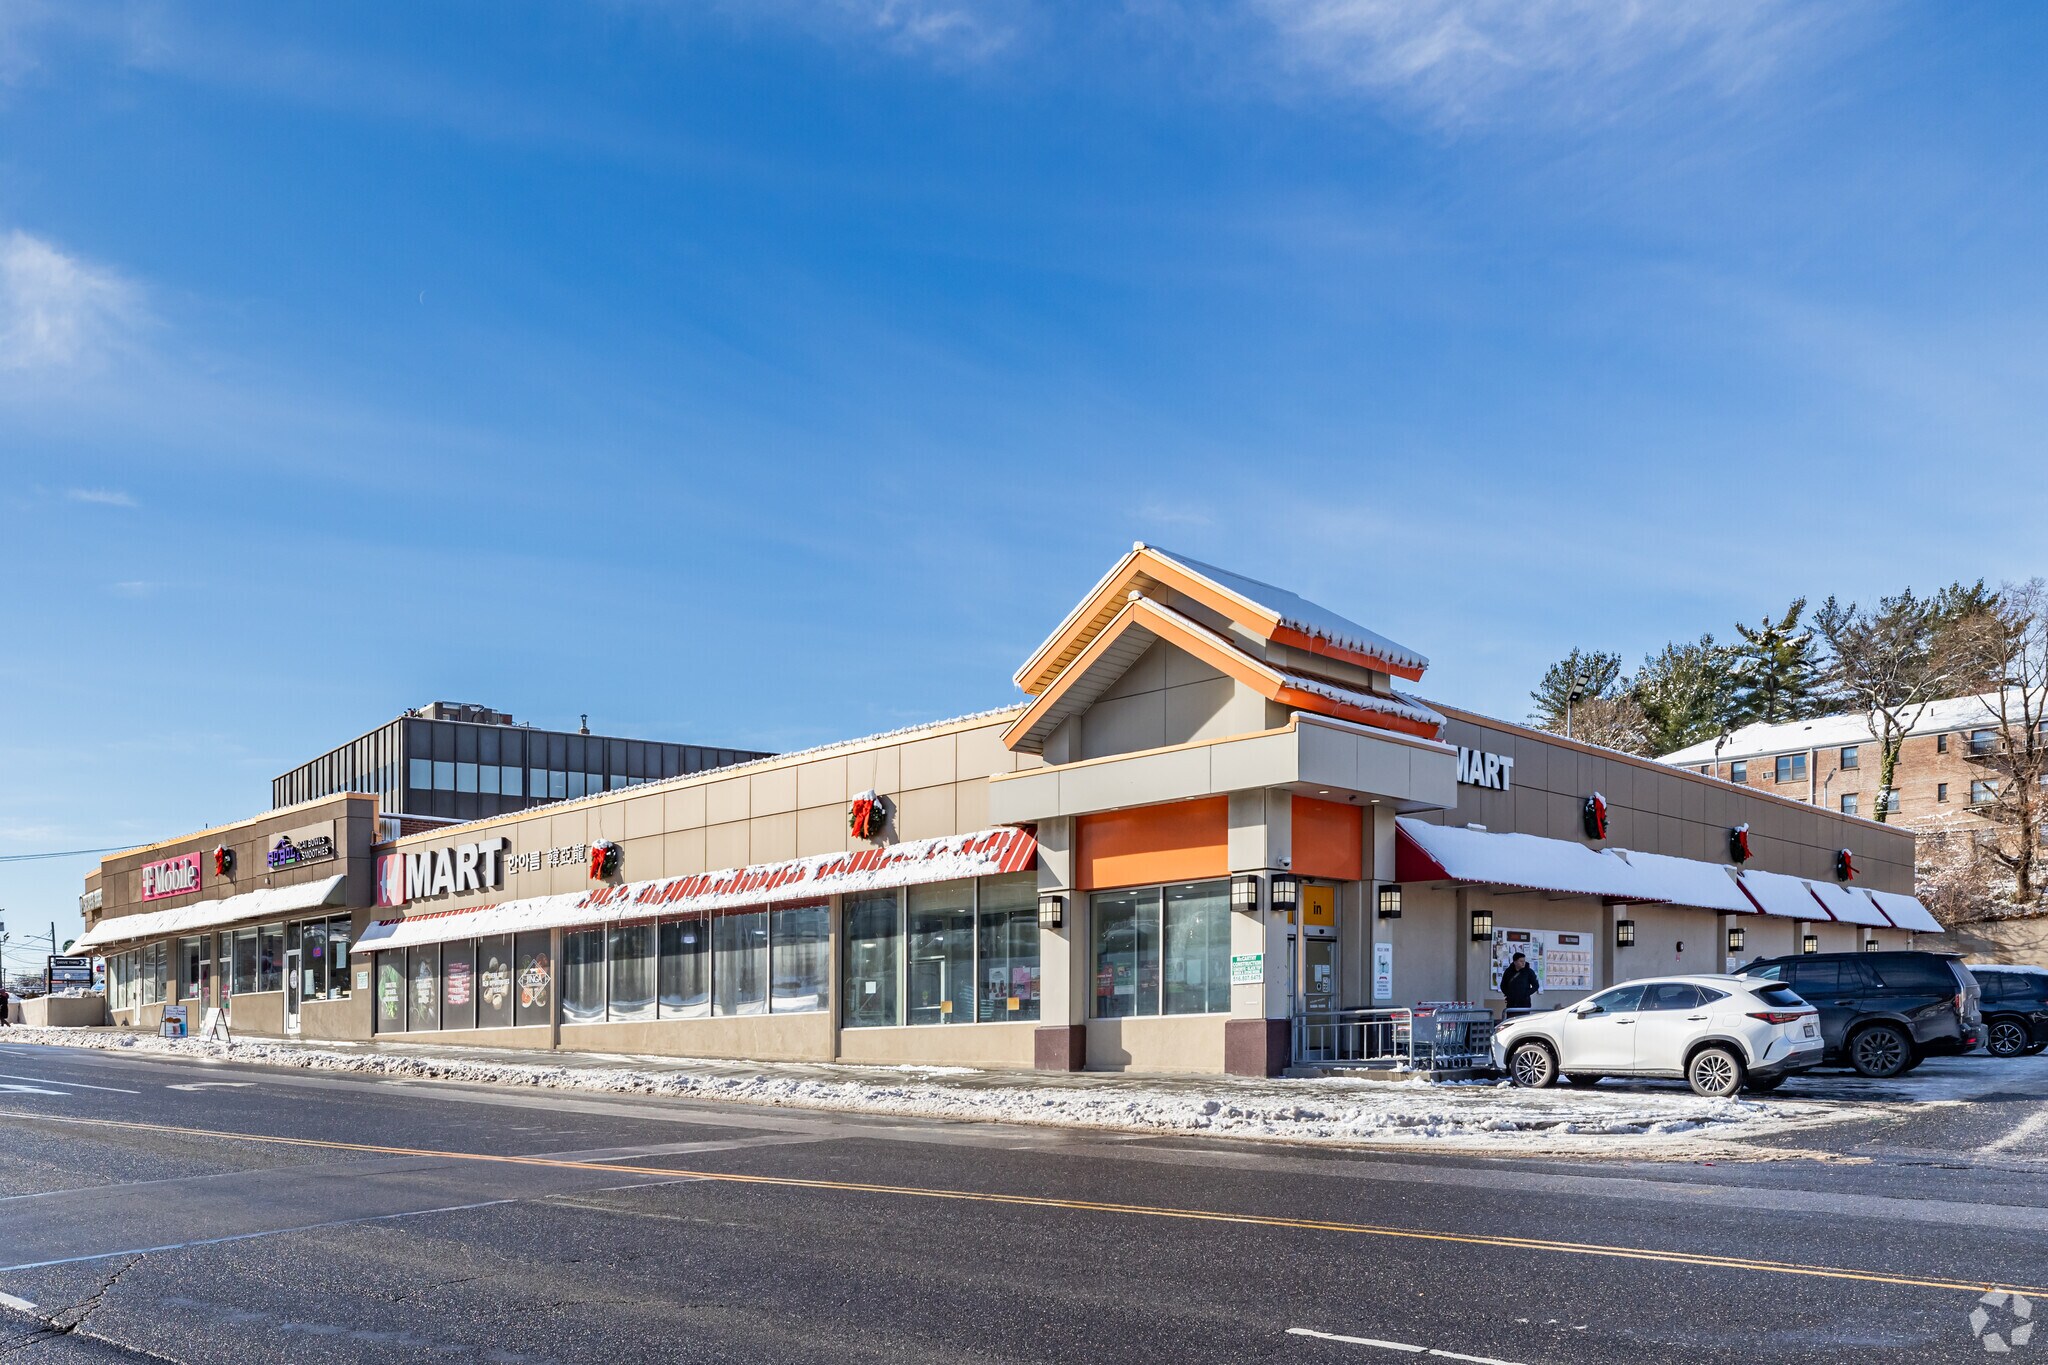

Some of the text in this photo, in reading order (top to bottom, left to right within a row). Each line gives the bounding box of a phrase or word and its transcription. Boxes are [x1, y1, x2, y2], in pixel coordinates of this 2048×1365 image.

[301, 846, 329, 860] SMOOTHIES
[406, 837, 503, 900] MART
[508, 851, 541, 874] 한아름
[1313, 901, 1322, 914] in
